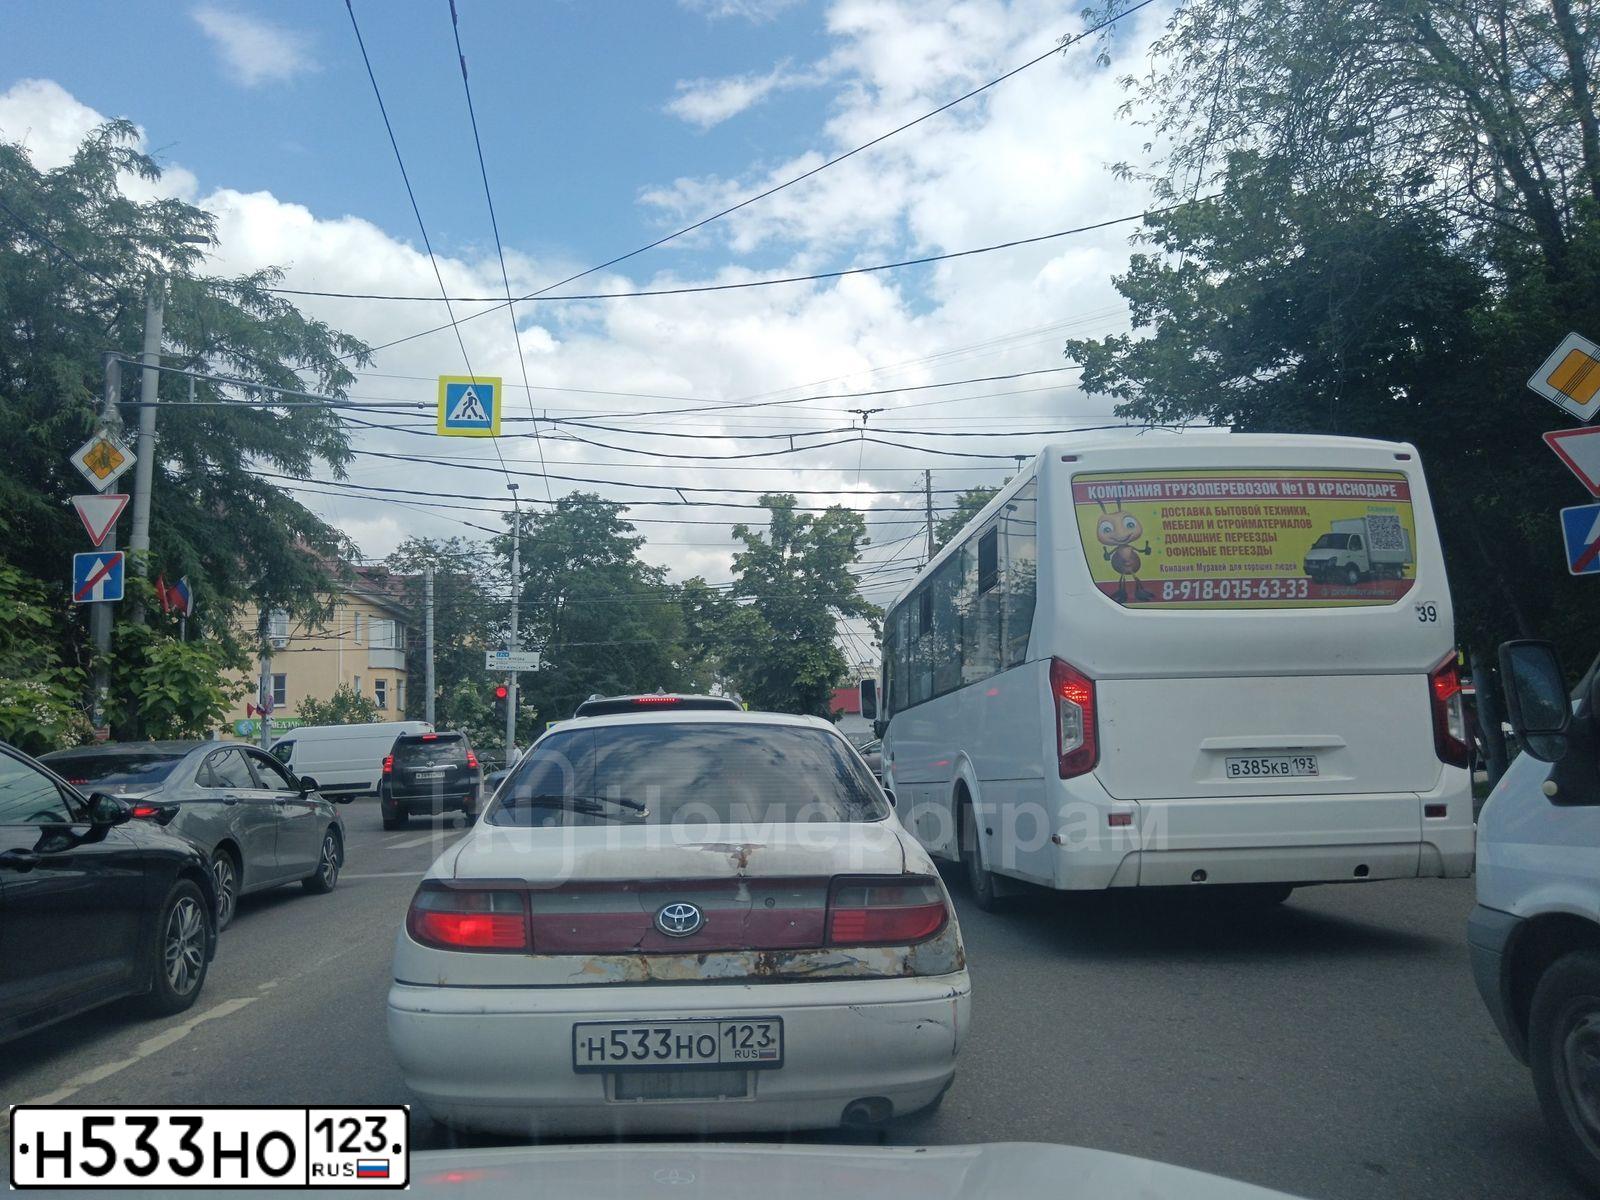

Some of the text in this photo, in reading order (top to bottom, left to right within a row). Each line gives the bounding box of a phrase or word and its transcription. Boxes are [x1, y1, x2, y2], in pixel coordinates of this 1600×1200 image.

[1088, 482, 1398, 499] КОМПАНИЯ ГРУЗОПЕРЕВОЗОК №1 В КРАСНОДАРЕ
[1161, 507, 1212, 518] ДОСТАВКА
[1215, 505, 1262, 516] БЫТОВОЙ
[1163, 518, 1313, 531] МЕБЕЛИ И СТРОЙМАТЕРИАЛОВ
[1164, 532, 1277, 544] ДОМАШНИЕ ПЕРЕЕЗДЫ
[1166, 546, 1272, 557] ОФИСНЫЕ ПЕРЕЕЗДЫ
[1160, 563, 1194, 573] Компания
[1196, 562, 1226, 573] Муравей
[1163, 579, 1308, 600] 8-918-075-63-33
[1418, 606, 1437, 622] 39
[1231, 758, 1313, 775] В385КВ 193
[588, 1024, 771, 1061] Н533НО 123
[734, 1049, 759, 1059] RUS
